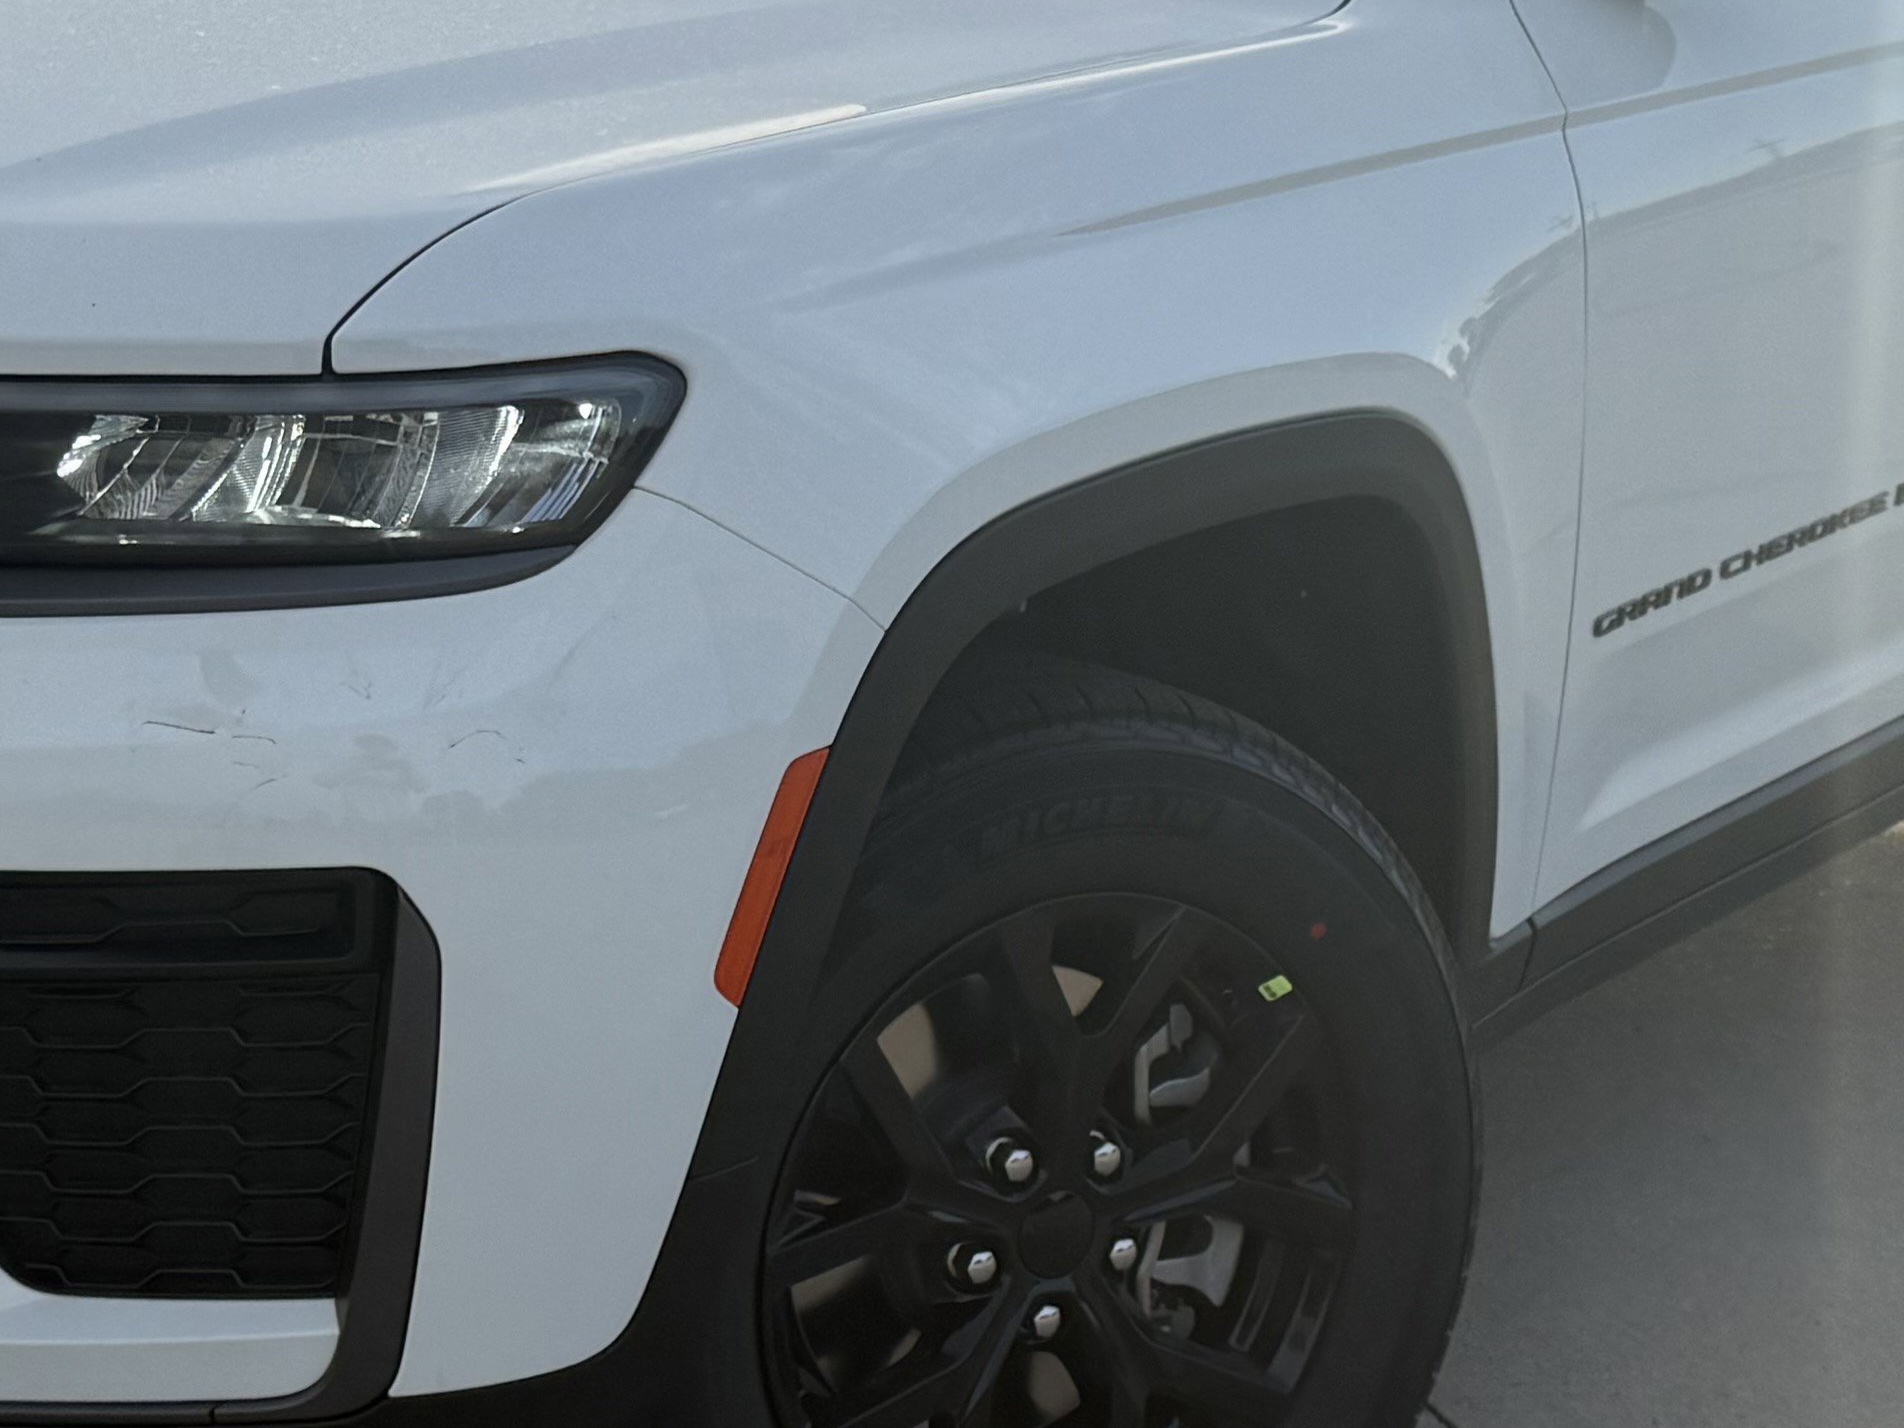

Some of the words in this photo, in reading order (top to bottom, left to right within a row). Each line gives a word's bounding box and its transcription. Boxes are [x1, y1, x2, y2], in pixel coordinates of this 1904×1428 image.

[1592, 568, 1712, 638] GRAND
[1719, 490, 1889, 581] CHEROKEE
[980, 792, 1216, 860] MICHELIN
